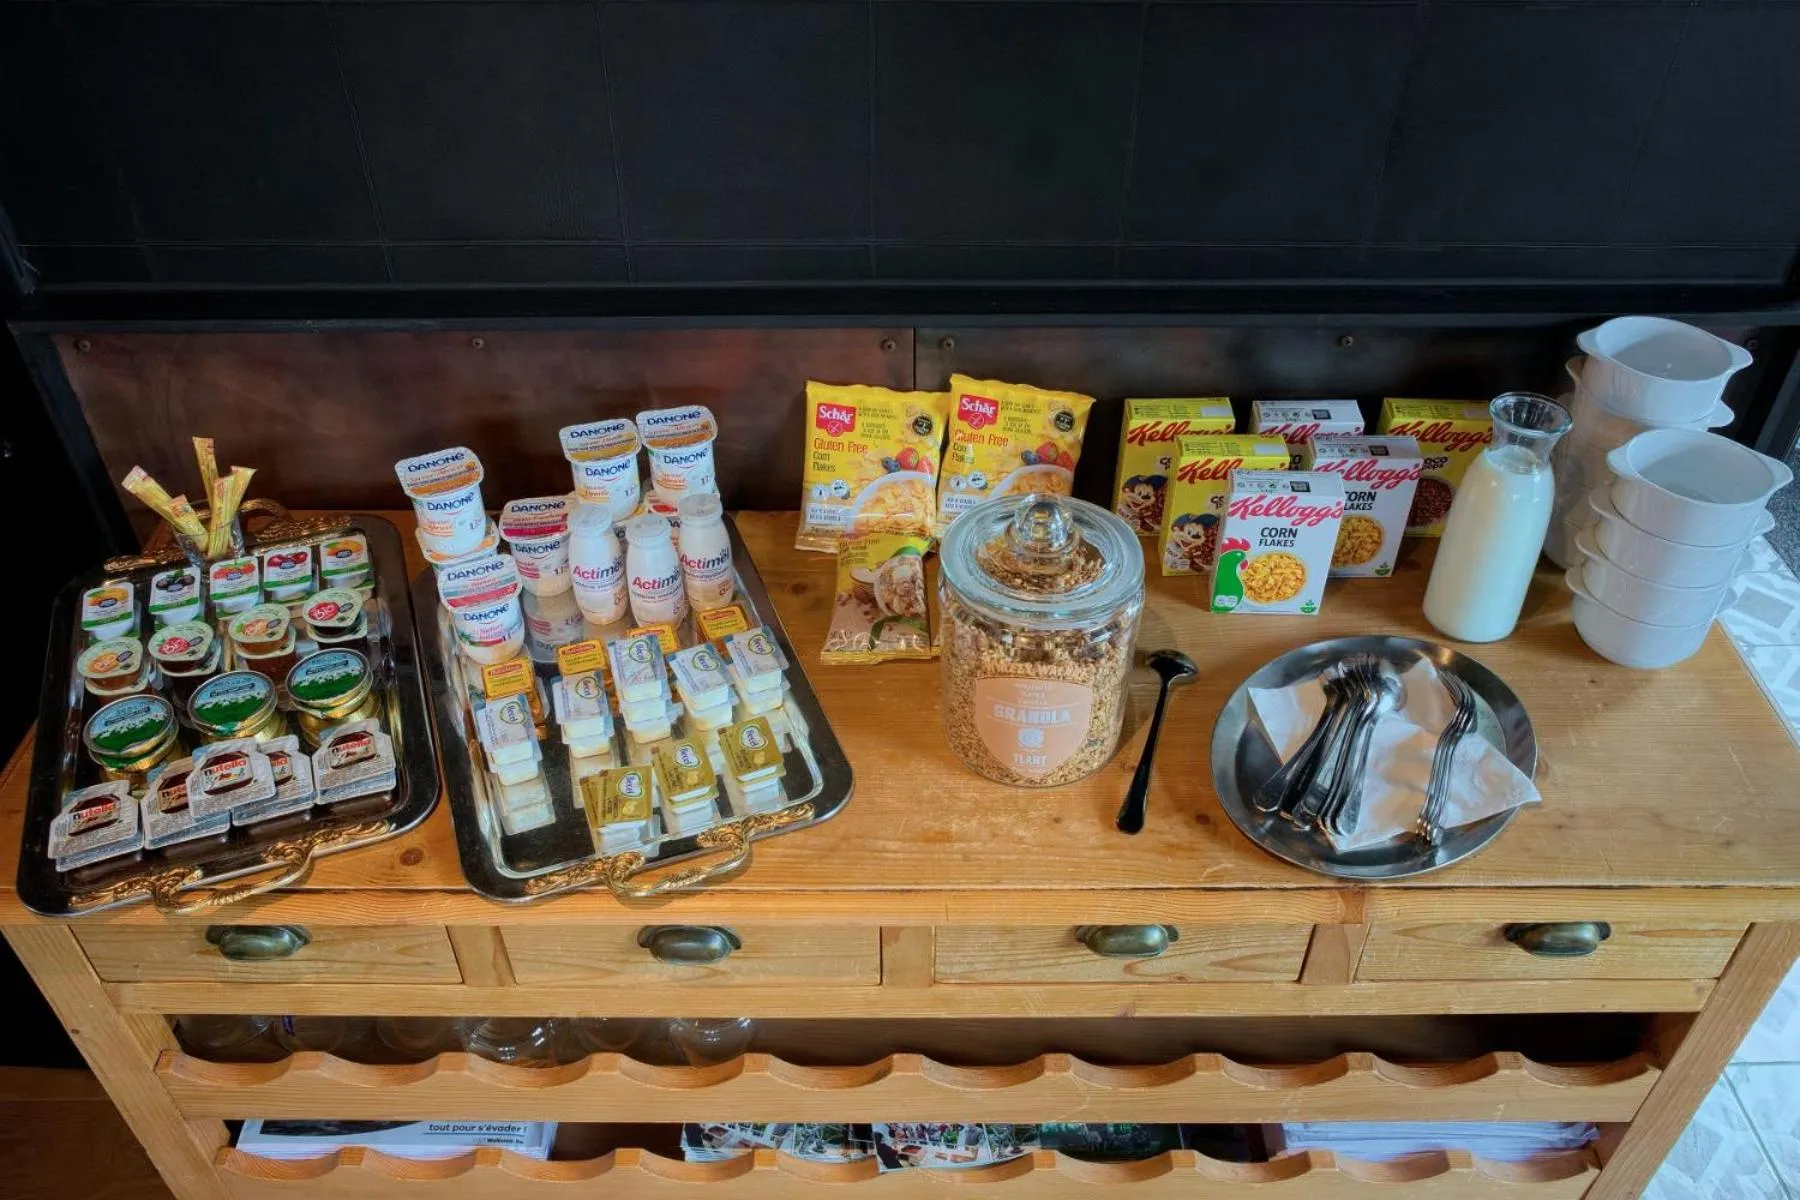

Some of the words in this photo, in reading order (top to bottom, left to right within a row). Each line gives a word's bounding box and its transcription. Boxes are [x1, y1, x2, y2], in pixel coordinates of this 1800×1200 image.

[647, 411, 702, 425] DANONE
[570, 423, 626, 439] DANONE
[814, 437, 844, 452] Gluten
[847, 441, 869, 454] Free
[988, 435, 1009, 447] Free
[408, 453, 465, 473] DANONE
[1344, 491, 1377, 502] ORN
[511, 501, 567, 514] DANONE
[1227, 494, 1344, 527] Kellogg's
[1344, 503, 1374, 511] LAKES
[1260, 527, 1298, 539] CORN
[1258, 538, 1295, 548] FLAKES
[447, 561, 505, 581] DANONE
[332, 738, 372, 754] nutella
[204, 757, 247, 776] nutella
[73, 800, 116, 820] nutella
[429, 1124, 451, 1132] tout
[452, 1125, 477, 1133] pour
